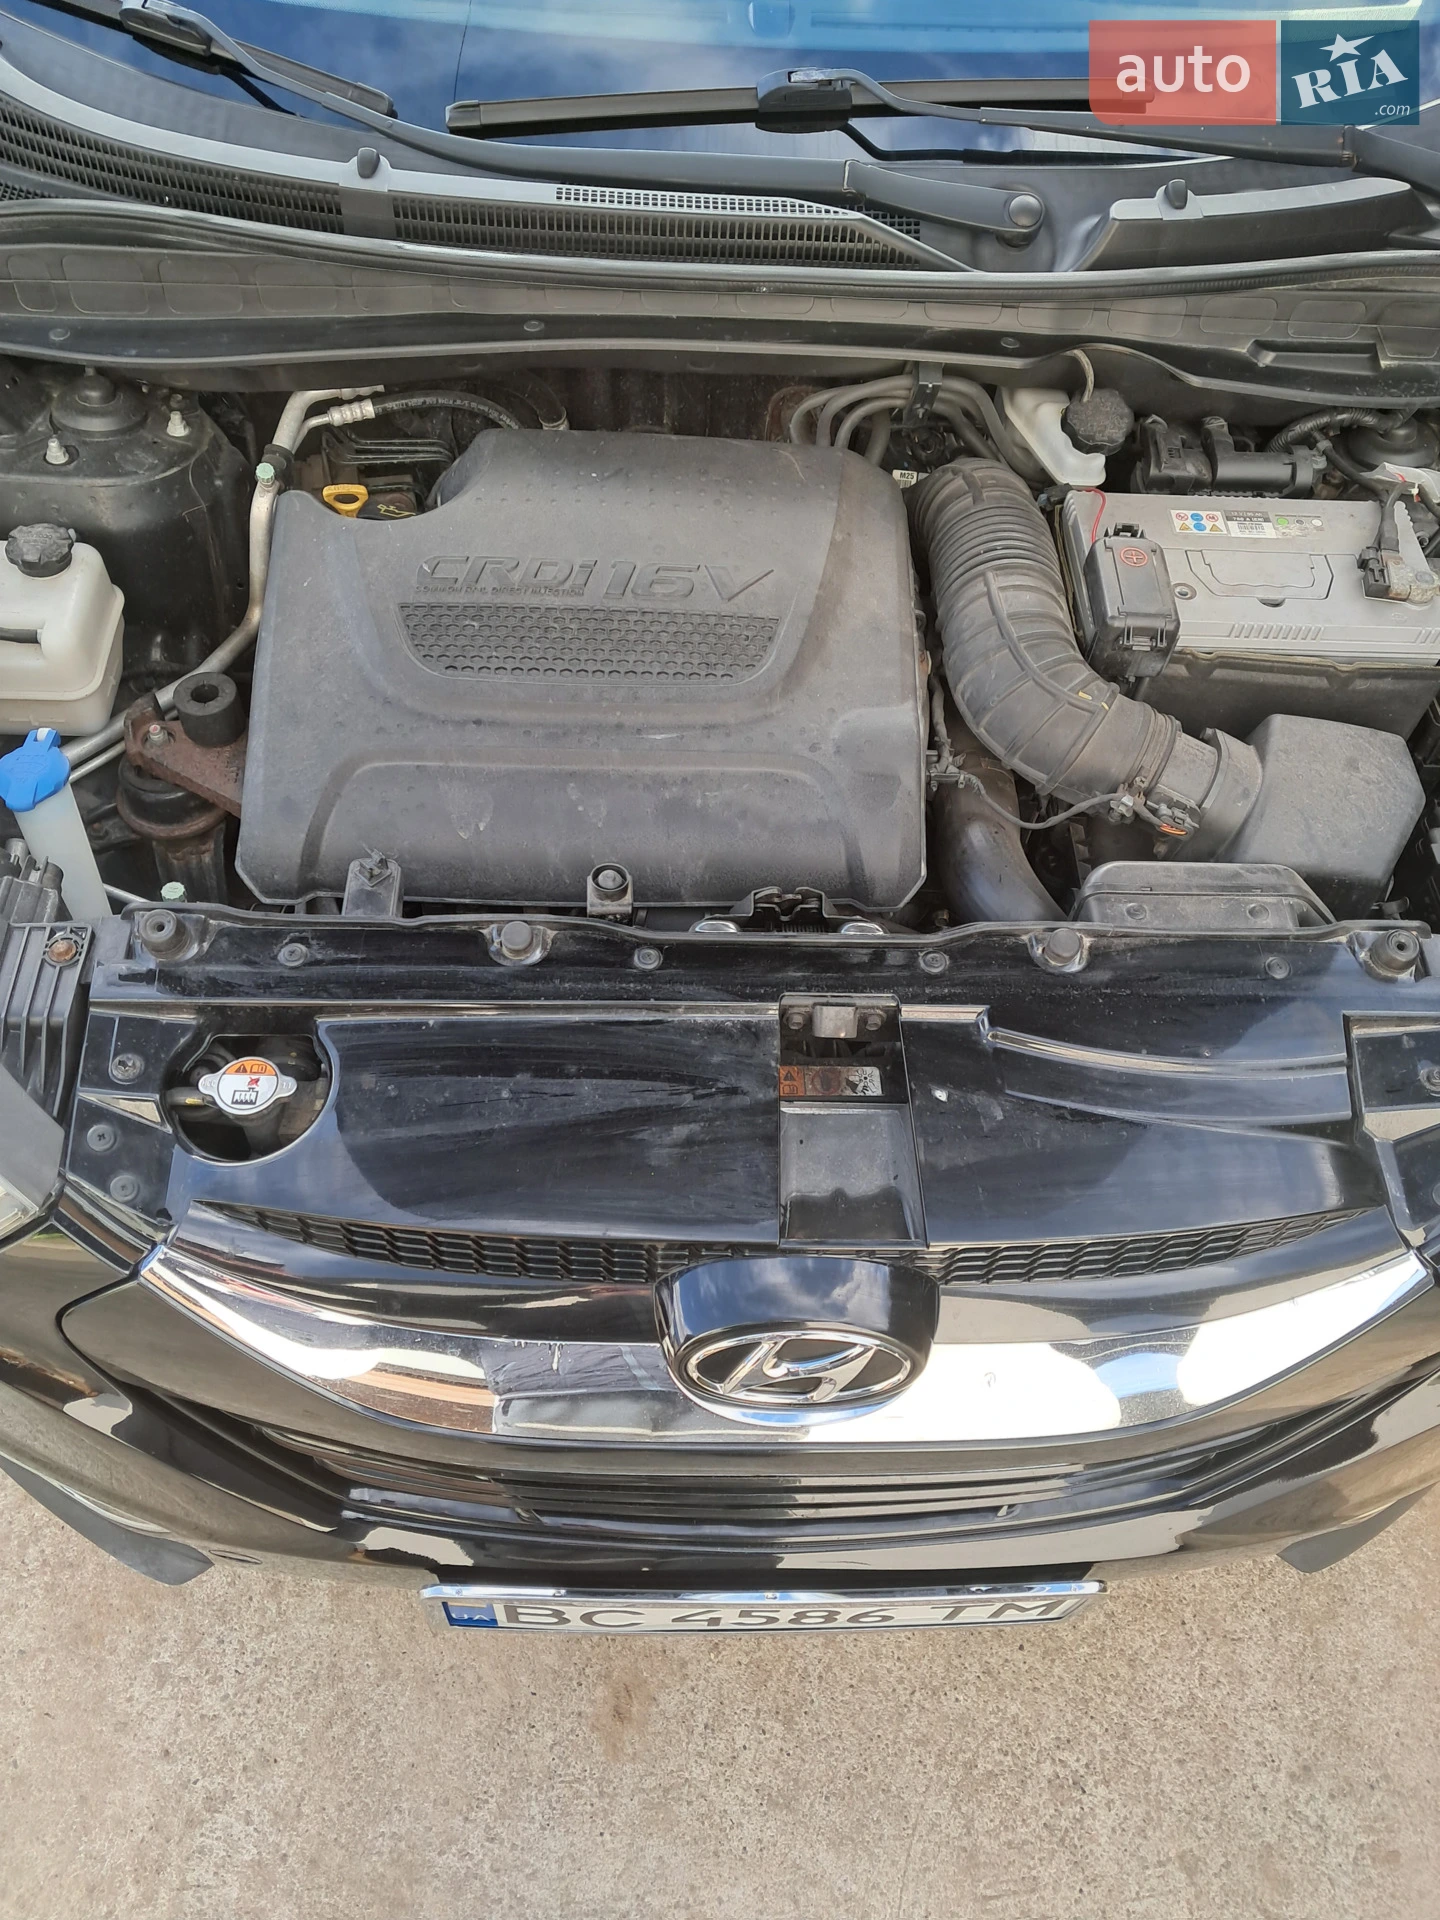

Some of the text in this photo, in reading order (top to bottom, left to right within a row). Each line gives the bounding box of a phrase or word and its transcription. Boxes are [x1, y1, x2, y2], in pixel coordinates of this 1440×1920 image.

[899, 472, 915, 480] M25
[602, 560, 775, 602] 16V
[451, 1611, 491, 1622] UA
[503, 1600, 1062, 1628] BC 4586 TM
